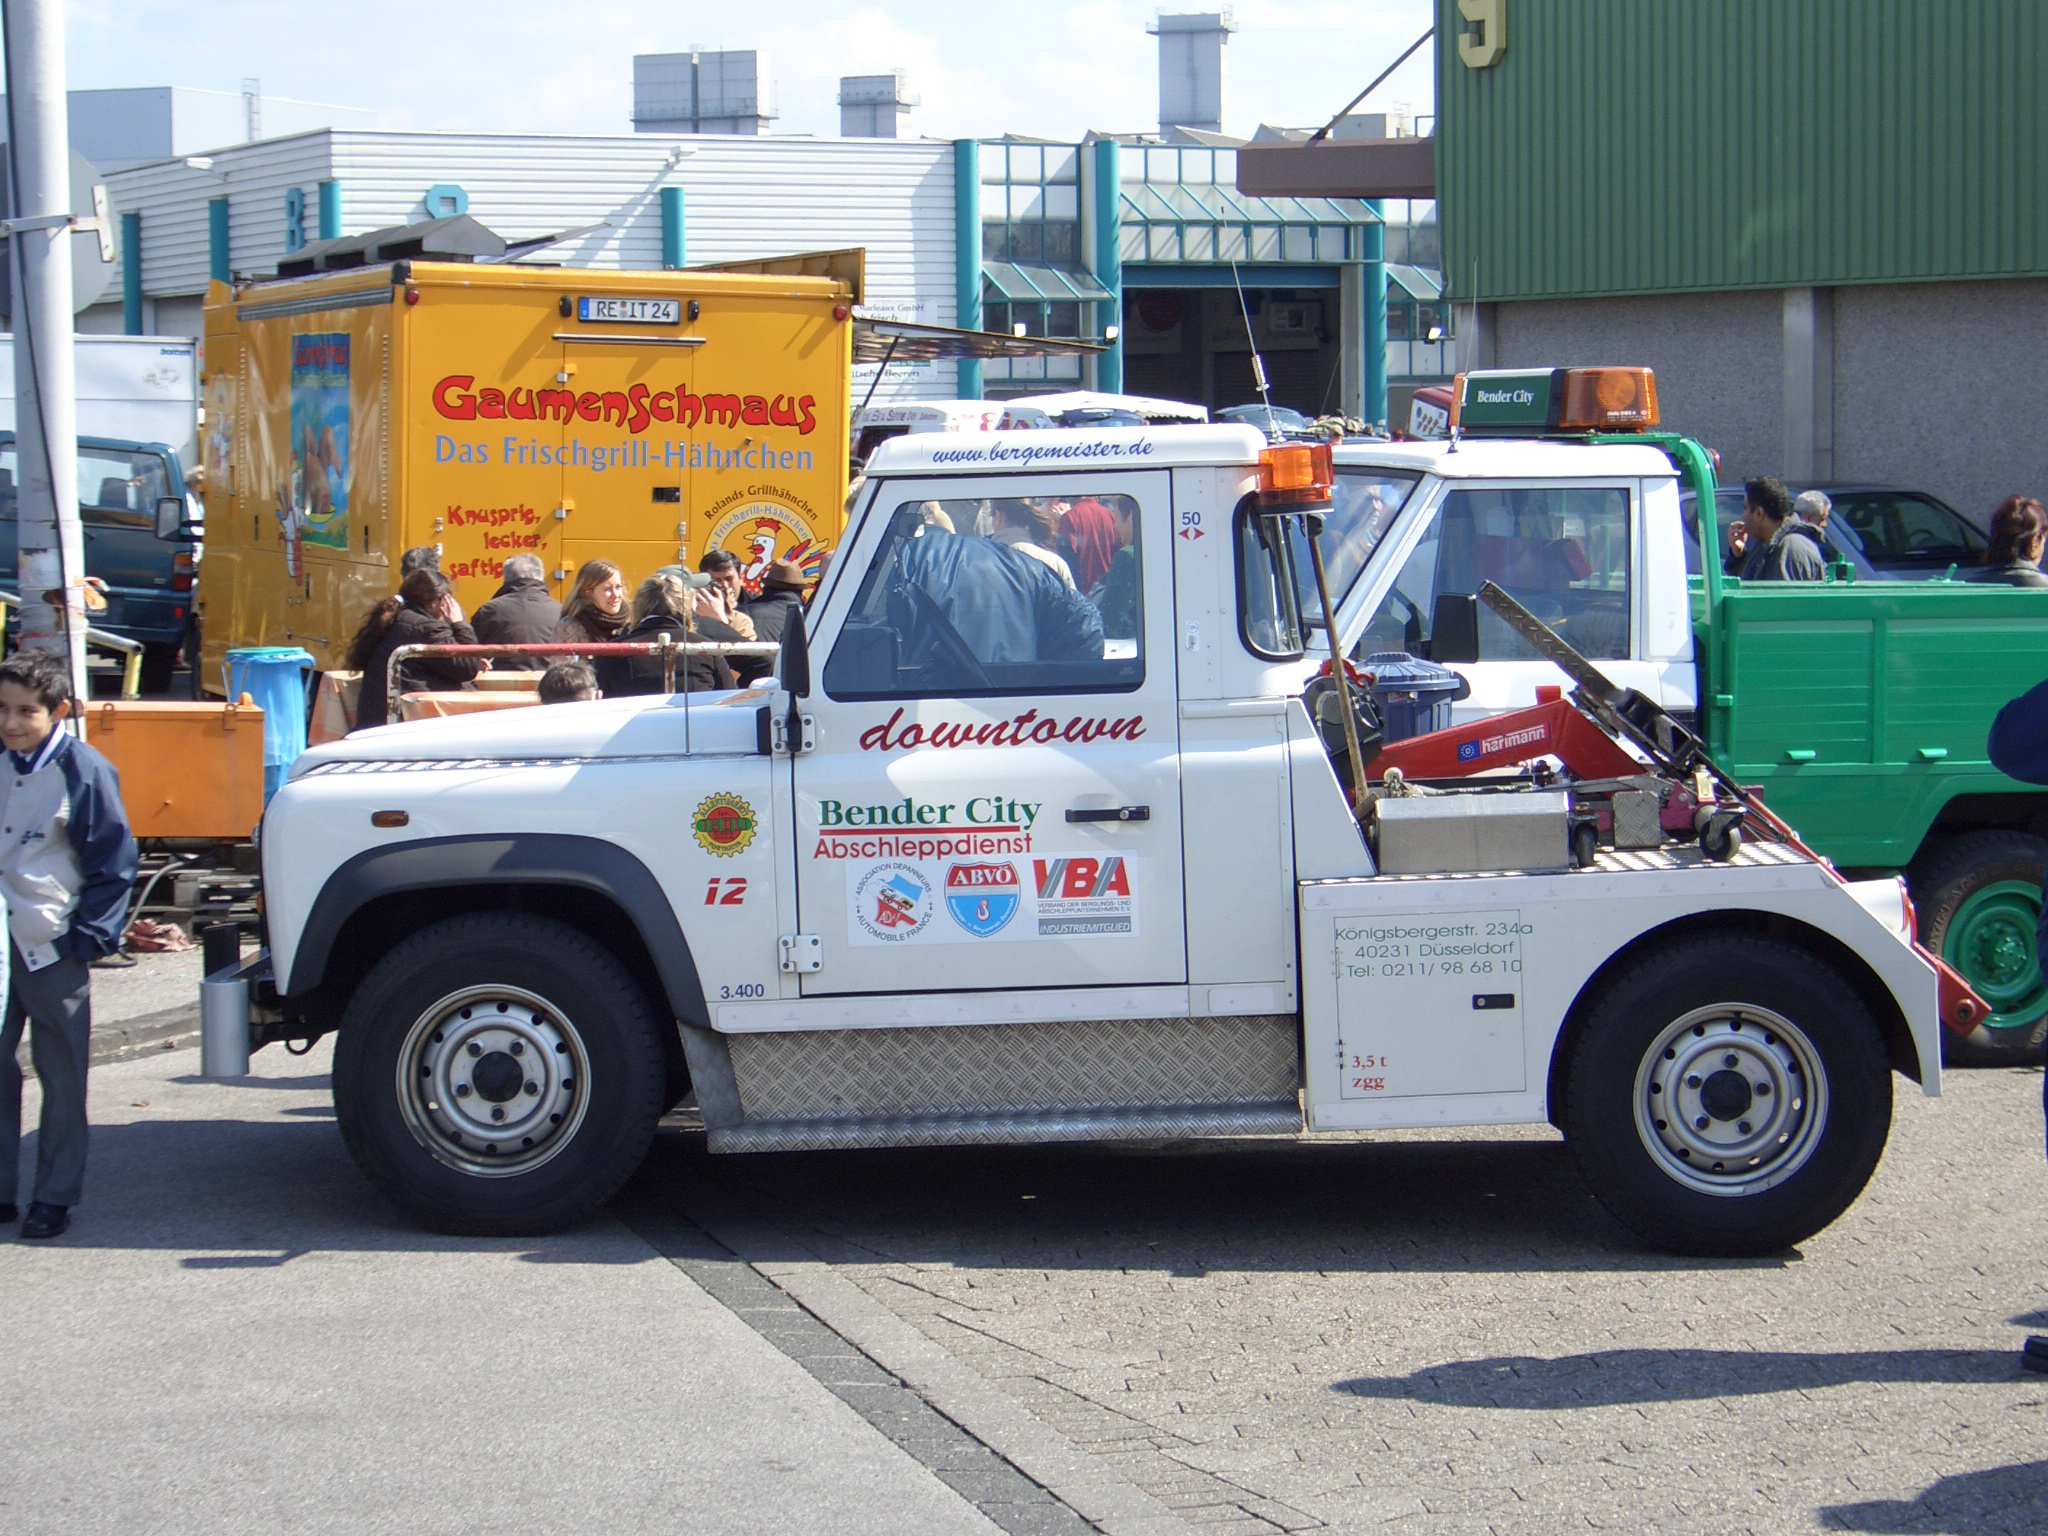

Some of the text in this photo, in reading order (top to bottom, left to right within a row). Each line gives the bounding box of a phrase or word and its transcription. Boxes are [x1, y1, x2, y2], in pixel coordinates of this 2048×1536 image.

[1477, 389, 1535, 407] Bender City
[434, 434, 814, 473] Das Frischgrill-Hähnchen
[932, 437, 1155, 466] www.bergemeister.de
[703, 484, 819, 522] Rolands Grillhähnchen
[447, 503, 542, 527] Knusprig,
[715, 505, 809, 541] Frischgrill-Hähnchen
[1181, 511, 1201, 526] 50
[483, 530, 548, 551] lecker,
[449, 556, 511, 581] saftig
[859, 706, 1147, 751] downtown
[818, 796, 1043, 831] Bender City
[814, 832, 1033, 861] Abschleppdienst
[855, 862, 932, 896] ASSOCIATION DEPANNEURS
[953, 865, 1012, 885] ABVÖ
[1032, 856, 1131, 899] VBA
[1038, 906, 1119, 914] ABSCHLEPPUNTERNEHMEN
[857, 914, 906, 942] AUTOMOBILE
[906, 911, 932, 939] FRANCE
[1040, 923, 1131, 934] INDUSTRIEMITGLIED
[1335, 922, 1533, 942] Königsbergerstr. 234a
[1354, 941, 1515, 959] 40231 Düsseldorf
[1347, 959, 1522, 978] Tel: 0211/ 98 68 10
[720, 984, 765, 999] 3.400
[1351, 1055, 1387, 1070] 3,5 t
[1352, 1076, 1385, 1090] zgg
